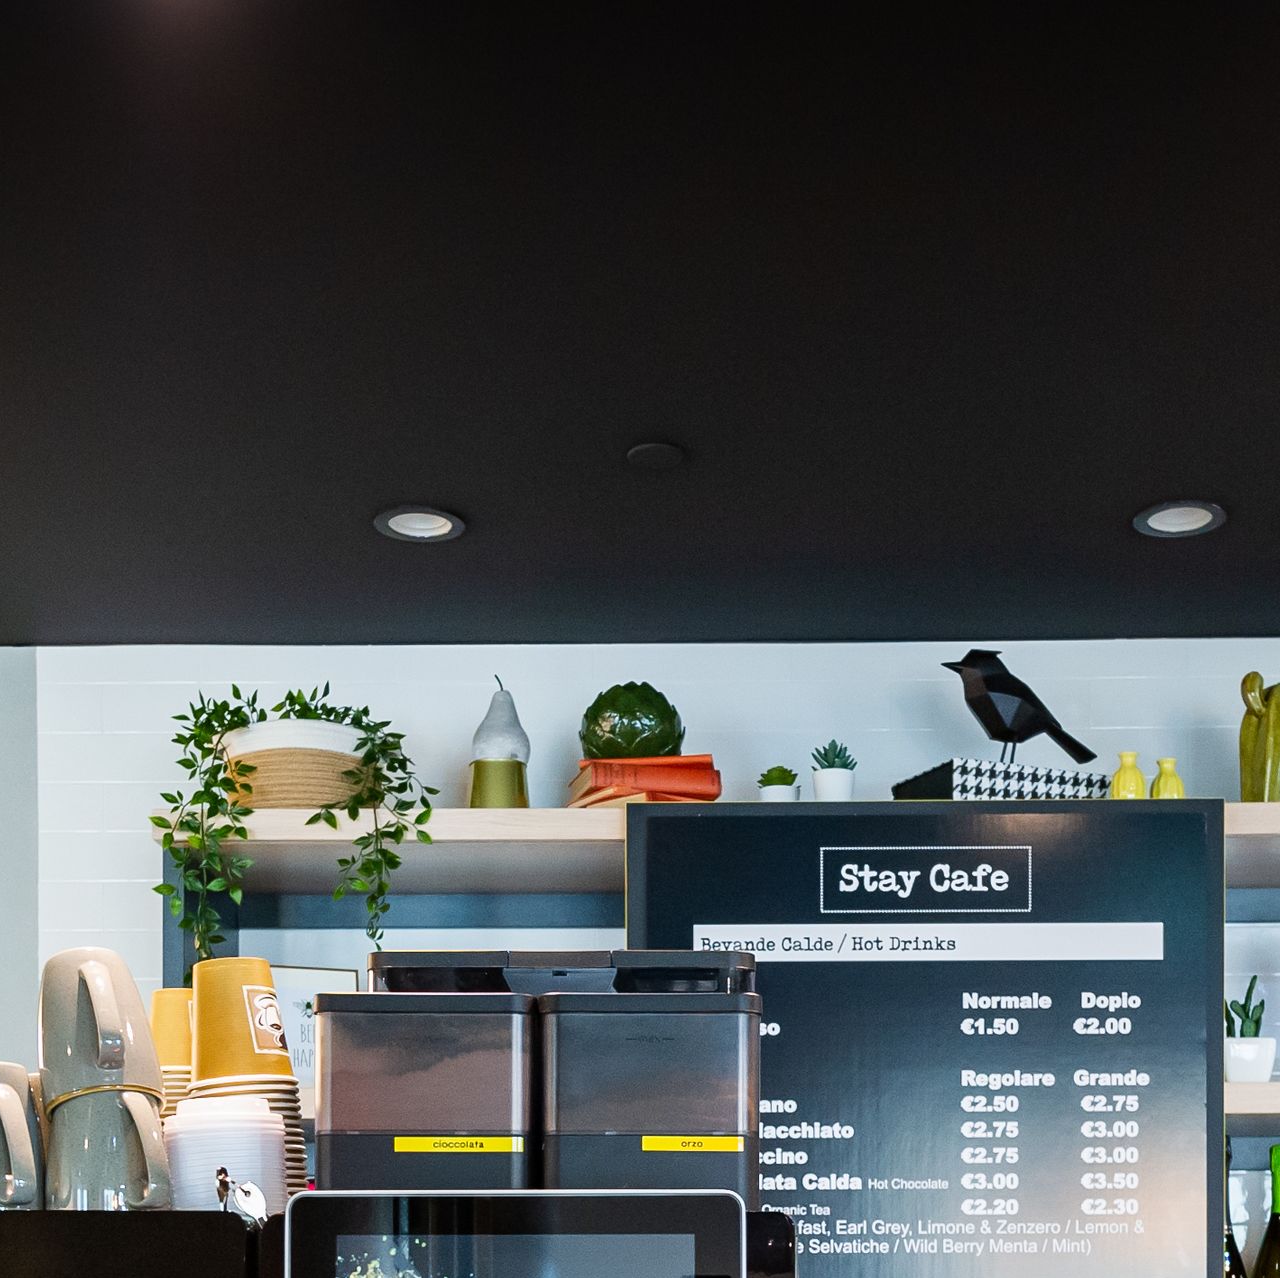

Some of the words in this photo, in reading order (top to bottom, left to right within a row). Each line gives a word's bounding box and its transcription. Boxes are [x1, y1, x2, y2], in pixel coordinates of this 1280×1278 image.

[839, 863, 920, 898] Stay
[929, 863, 1009, 893] Cafe
[701, 936, 776, 951] Bevande
[781, 936, 834, 951] Calde
[851, 936, 883, 951] Hot
[889, 935, 957, 951] Drinks
[962, 992, 1053, 1009] Normale
[960, 1018, 1019, 1035] €1.50
[1073, 1018, 1132, 1035] €2.00
[961, 1069, 1056, 1090] Regolare
[1073, 1069, 1151, 1086] Grande
[960, 1095, 1019, 1112] €2.50
[1080, 1095, 1140, 1112] €2.75
[960, 1121, 1019, 1138] €2.75
[1080, 1121, 1140, 1138] €3.00
[432, 1140, 485, 1149] cioccolata
[680, 1140, 704, 1148] orzo
[960, 1147, 1019, 1164] €2.75
[1080, 1147, 1140, 1164] €3.00
[802, 1173, 863, 1190] Calda
[868, 1178, 888, 1190] Hot
[891, 1178, 949, 1190] Chocolate
[960, 1173, 1019, 1190] €3.00
[1080, 1173, 1140, 1190] €3.50
[810, 1204, 831, 1216] Tea
[960, 1198, 1019, 1216] €2.20
[1080, 1198, 1140, 1216] €2.30
[835, 1219, 867, 1235] Earl
[872, 1219, 913, 1238] Grey,
[918, 1219, 975, 1235] Limone
[980, 1219, 992, 1235] &
[996, 1219, 1061, 1235] Zenzero
[1075, 1219, 1129, 1235] Lemon
[1134, 1219, 1145, 1235] &
[808, 1238, 890, 1254] Selvatiche
[903, 1238, 939, 1254] Wild
[943, 1238, 985, 1257] Berry
[989, 1238, 1038, 1254] Menta
[1052, 1238, 1092, 1256] Mint)
